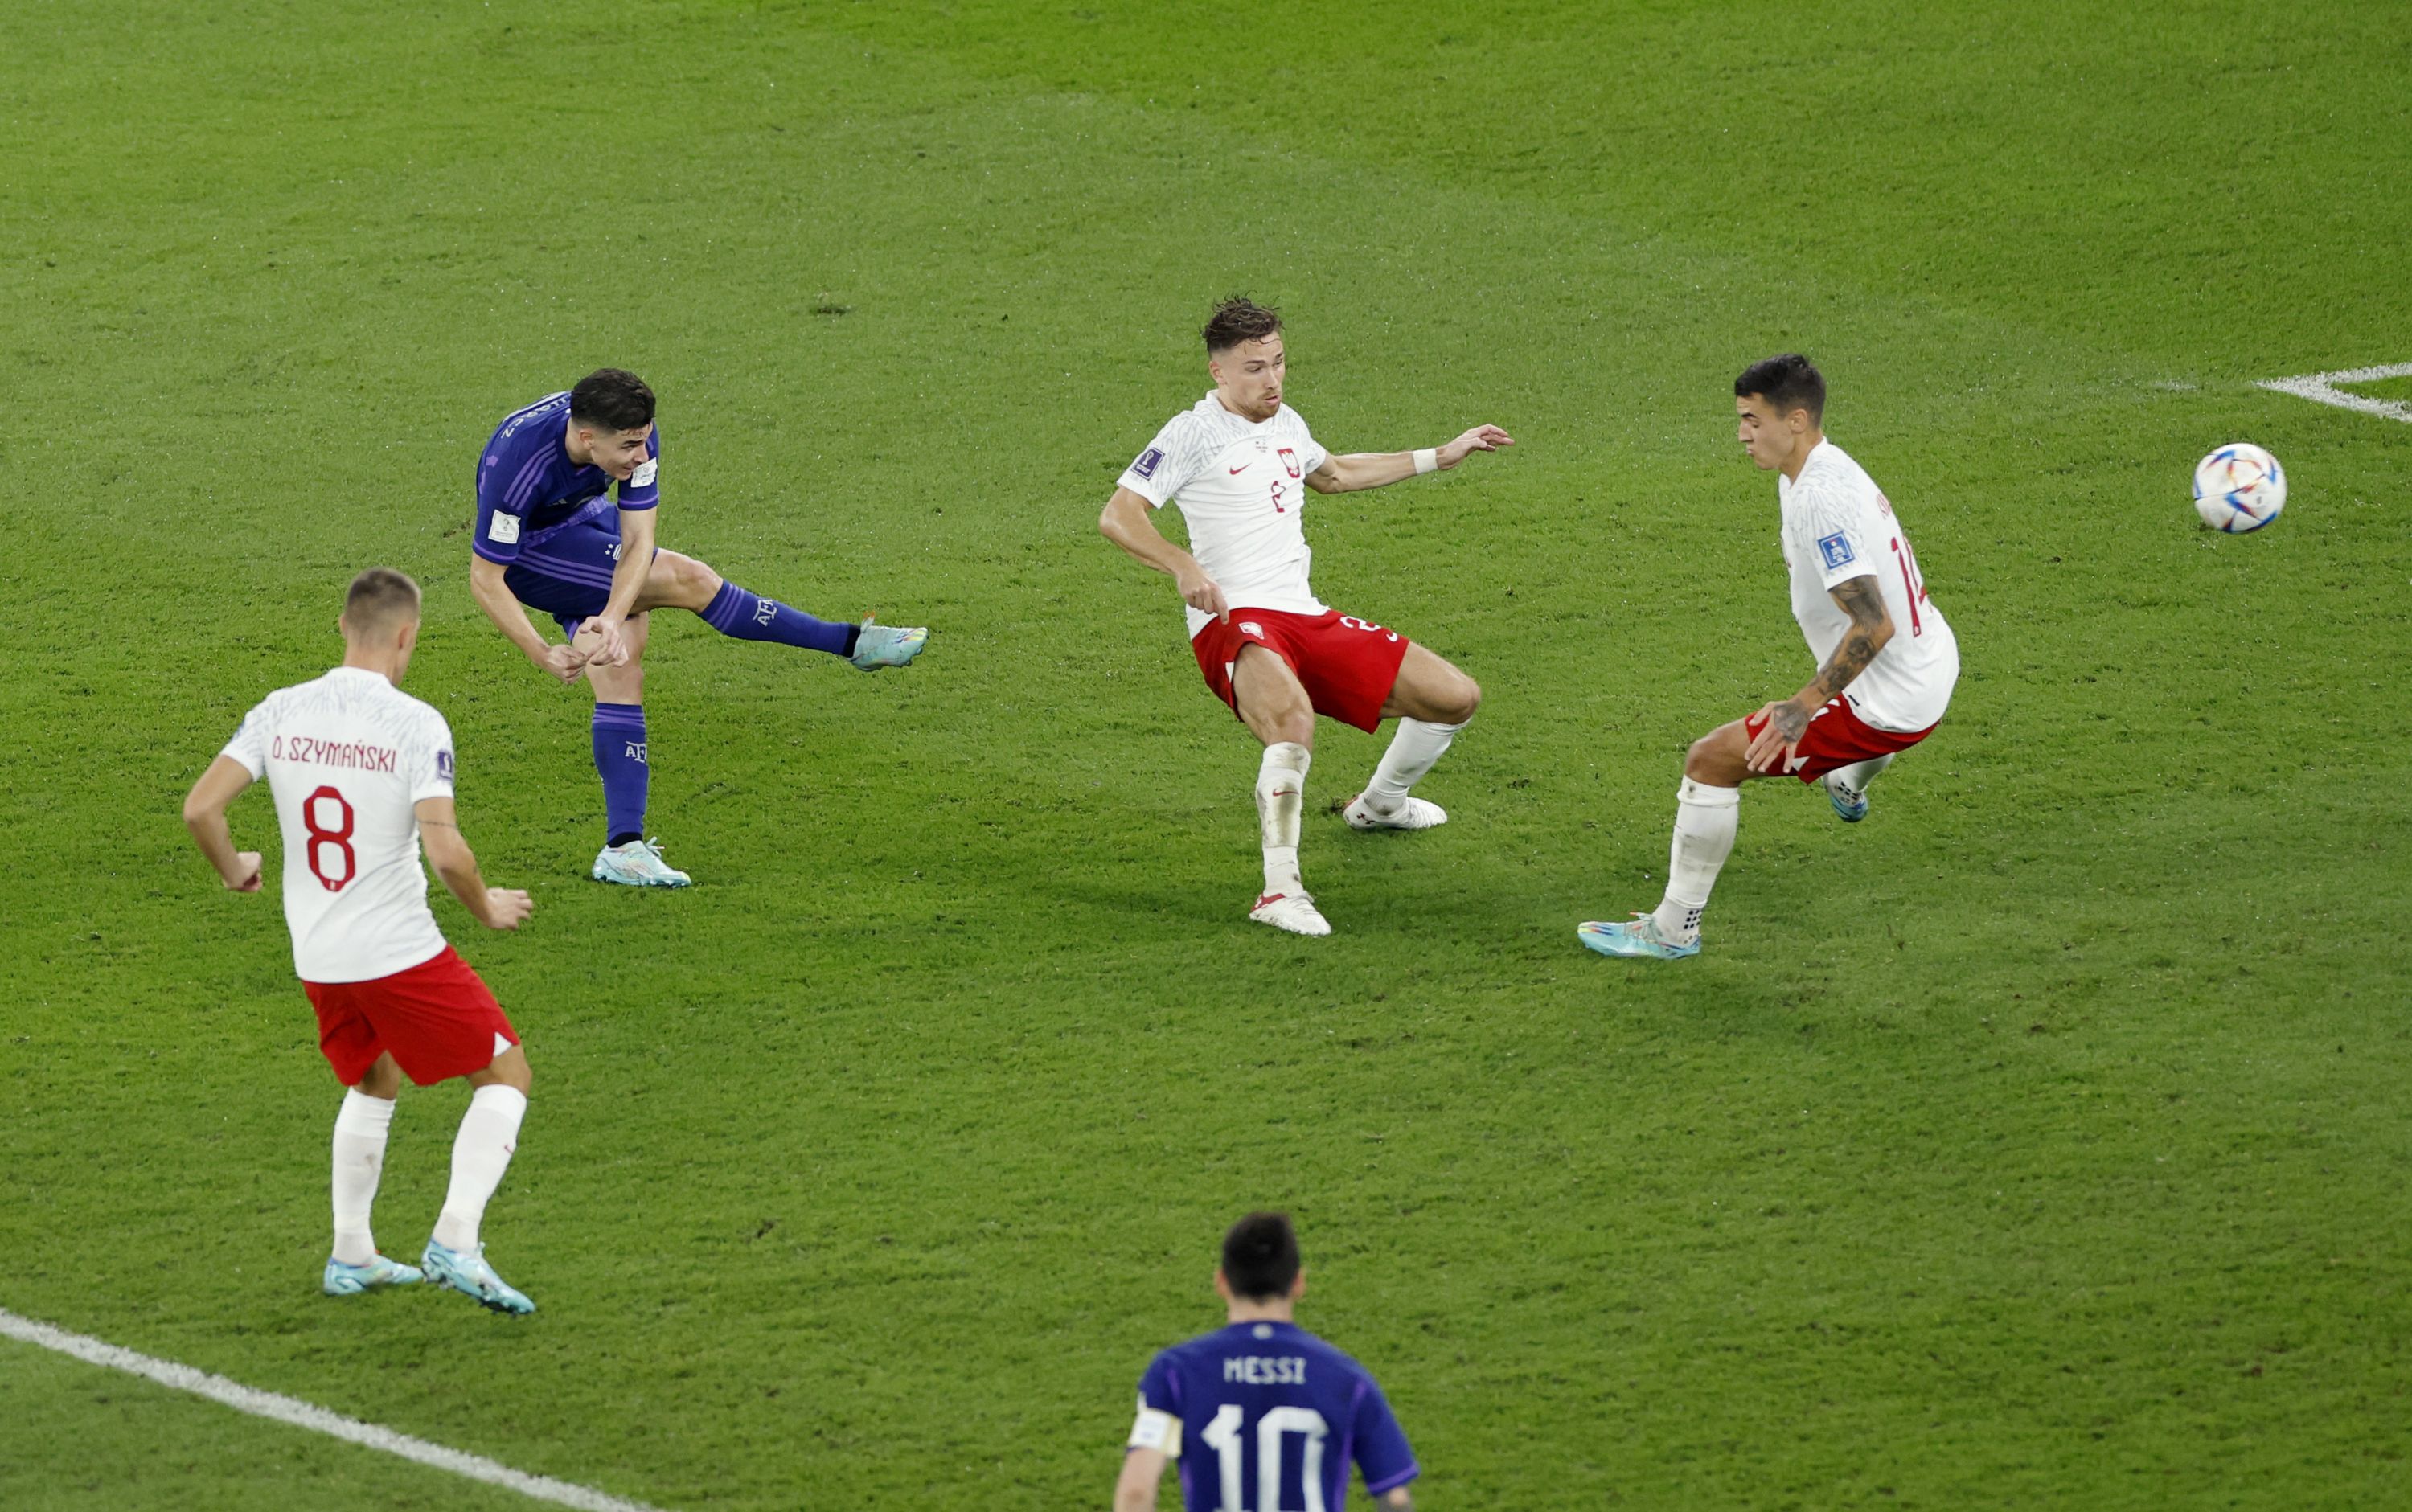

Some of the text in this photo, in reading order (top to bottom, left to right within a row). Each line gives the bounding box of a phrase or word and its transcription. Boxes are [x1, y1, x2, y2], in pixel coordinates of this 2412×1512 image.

[303, 785, 355, 893] 8
[1223, 1356, 1307, 1385] MESSI
[1200, 1403, 1330, 1512] 10
